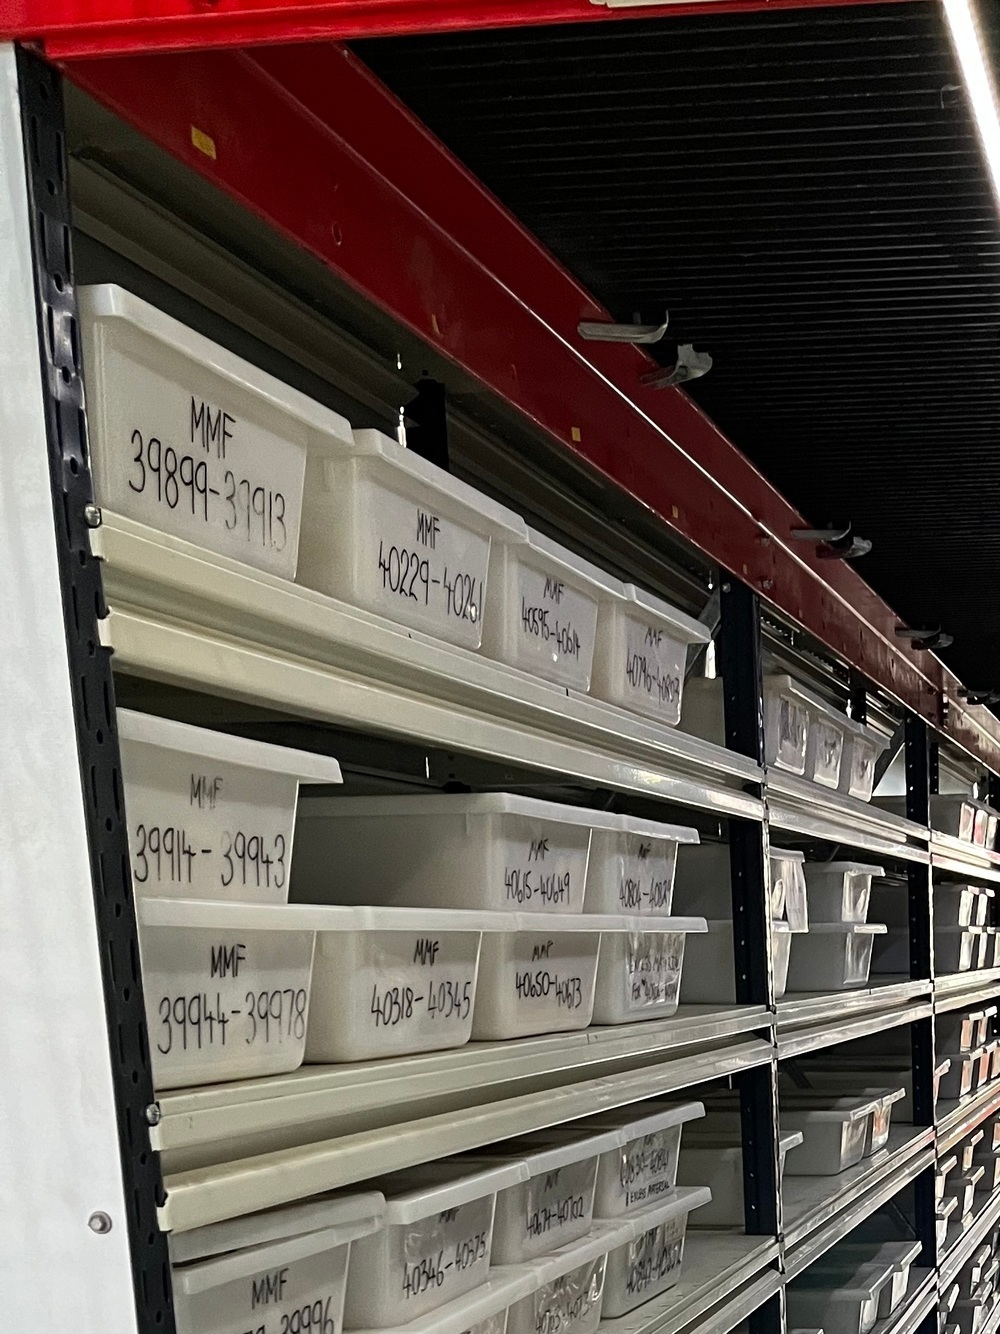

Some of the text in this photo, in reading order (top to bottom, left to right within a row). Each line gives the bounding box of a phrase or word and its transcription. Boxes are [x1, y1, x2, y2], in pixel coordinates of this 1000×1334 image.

[191, 396, 236, 459] MMF
[416, 508, 441, 549] MMF
[190, 773, 223, 809] MMF
[211, 944, 246, 978] MMF
[413, 938, 440, 967] MMF
[252, 1267, 290, 1310] MMF
